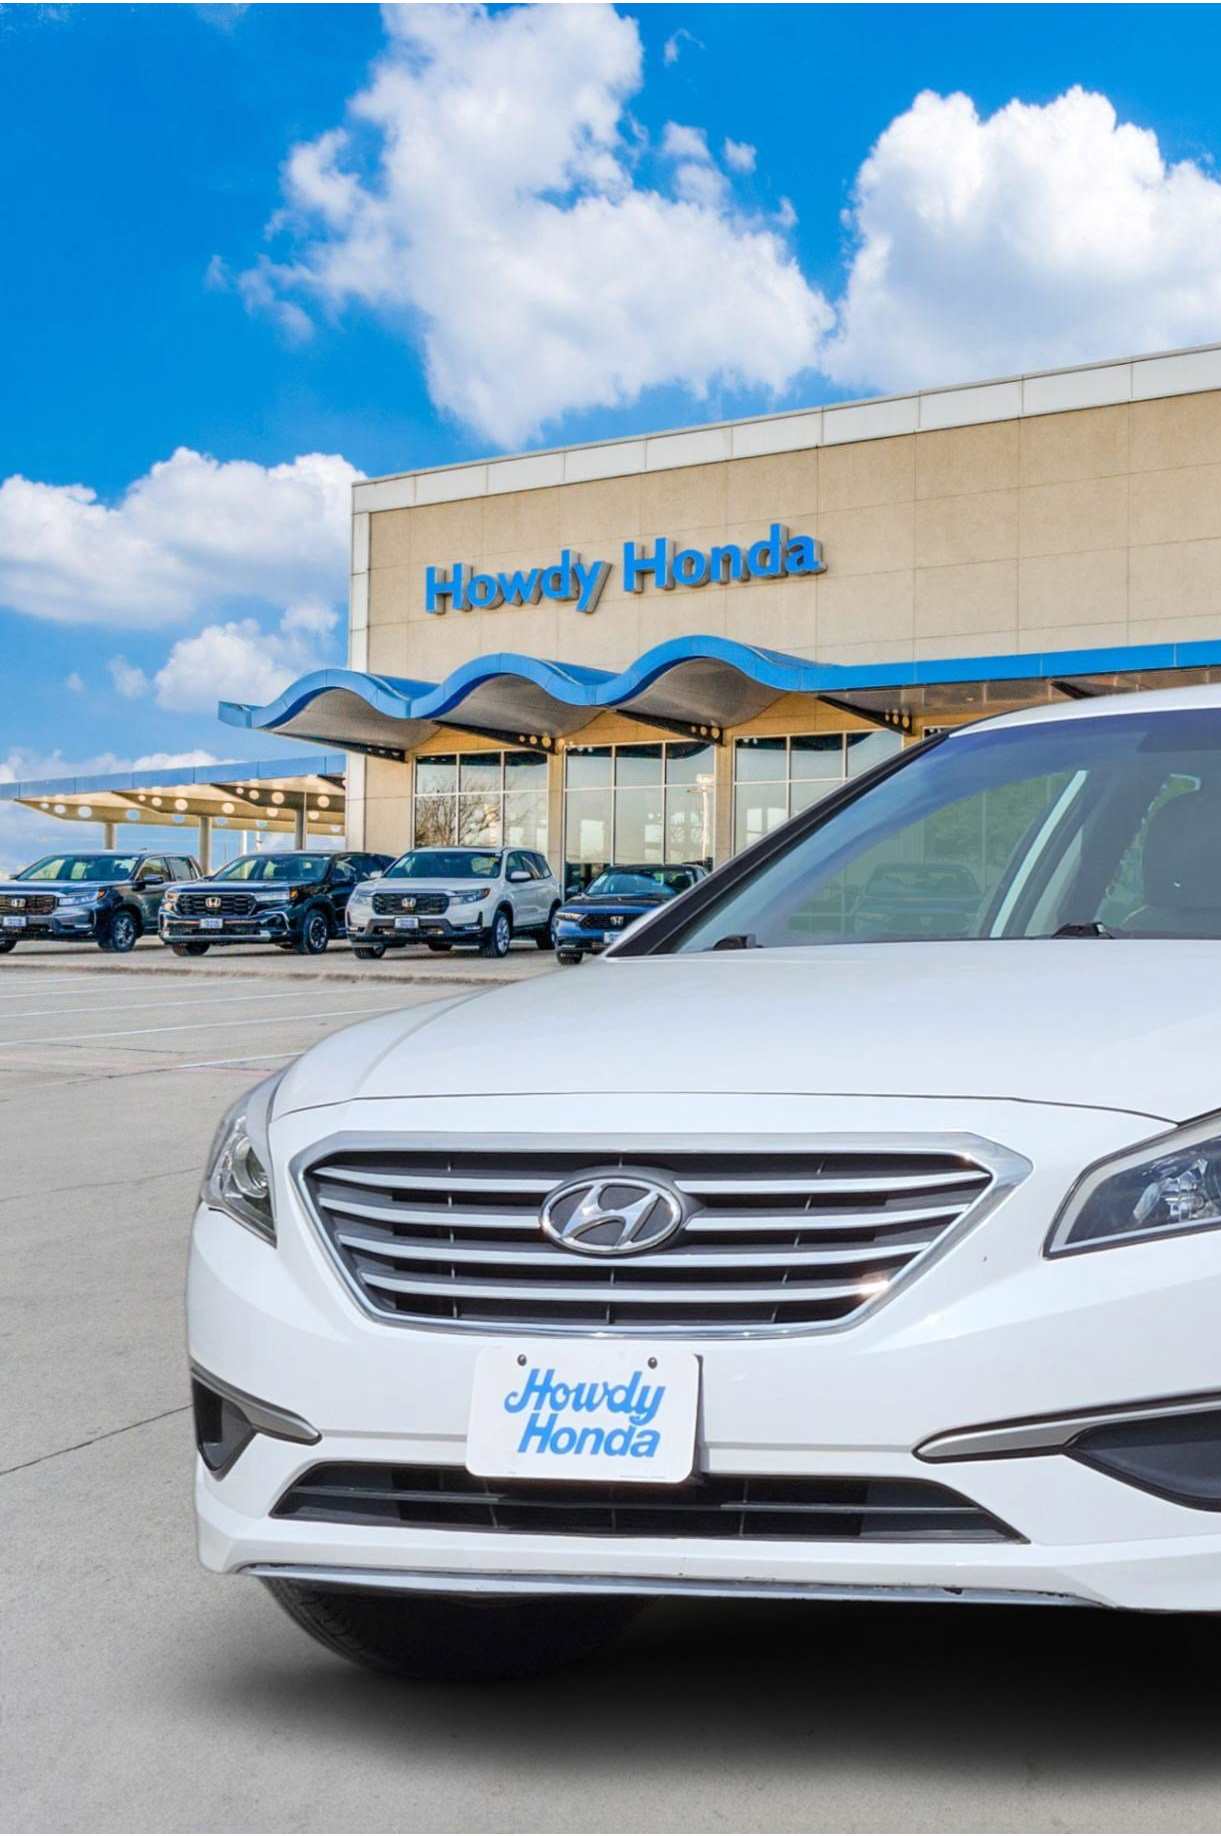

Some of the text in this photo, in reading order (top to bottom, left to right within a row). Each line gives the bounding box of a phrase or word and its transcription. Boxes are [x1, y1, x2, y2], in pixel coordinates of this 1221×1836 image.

[425, 523, 826, 614] Howdy Honda
[504, 1368, 667, 1425] Howdy
[517, 1412, 661, 1458] Honda
